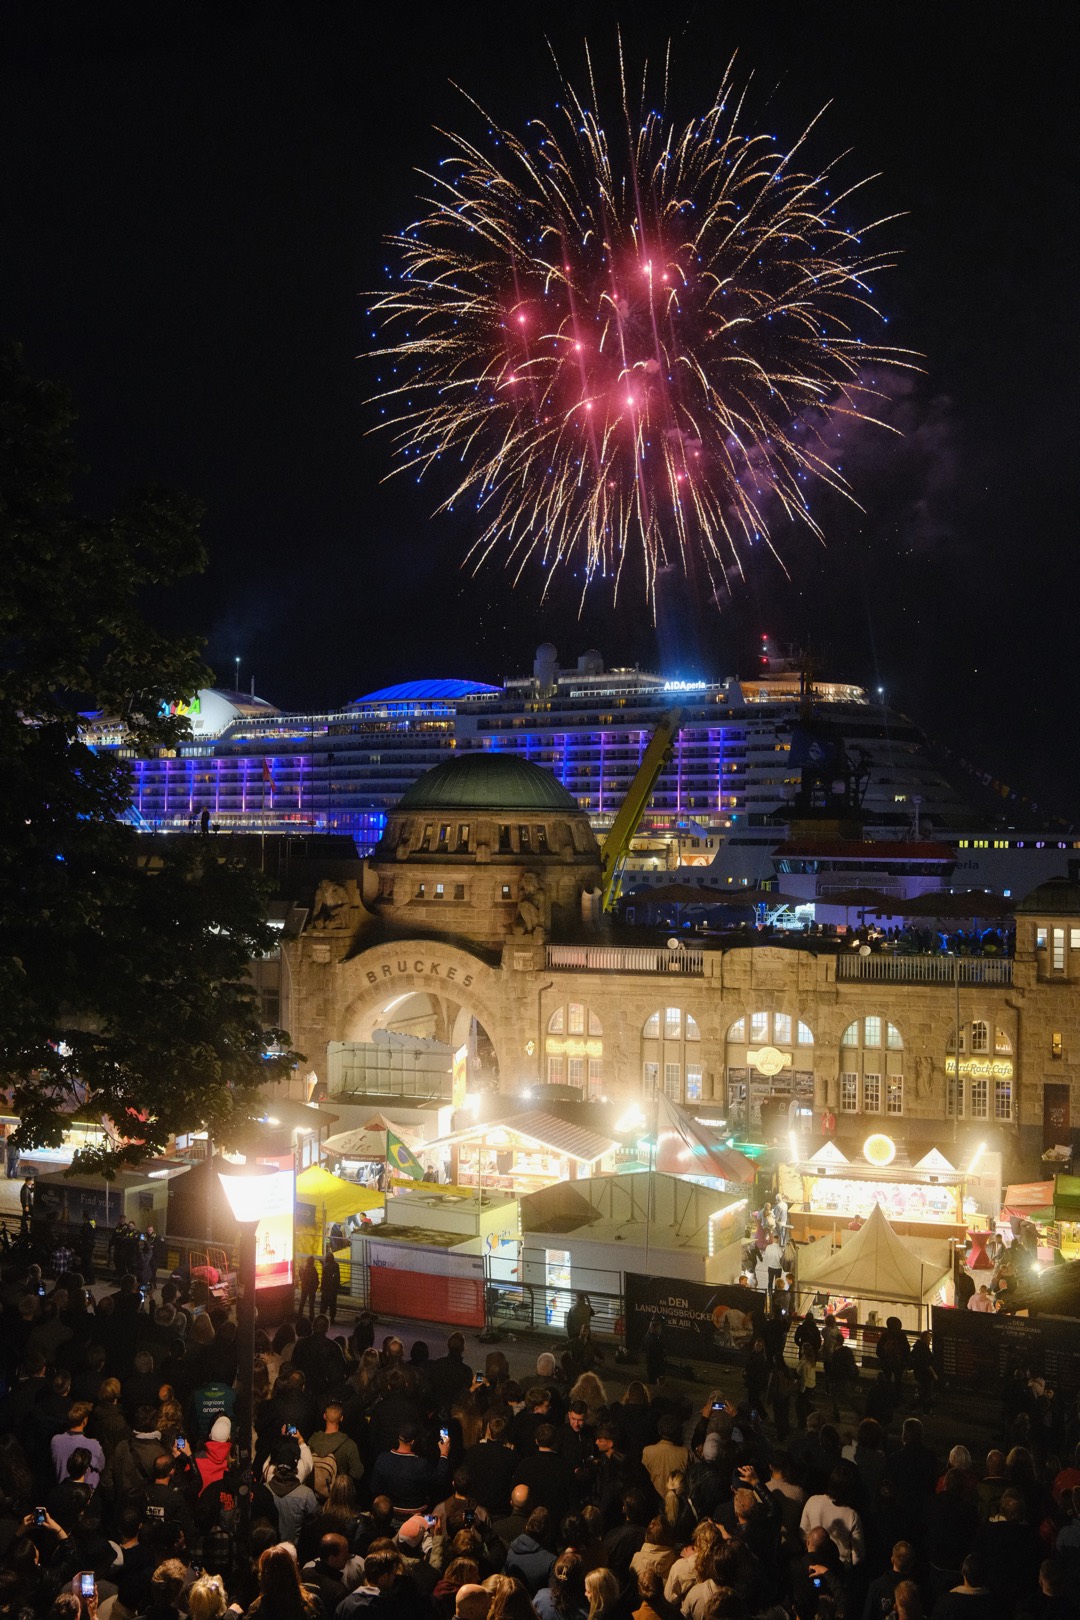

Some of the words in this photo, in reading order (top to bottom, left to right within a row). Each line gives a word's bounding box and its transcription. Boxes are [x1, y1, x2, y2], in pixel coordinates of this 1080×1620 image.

[664, 680, 706, 691] AIDAperla
[956, 860, 979, 870] erla
[970, 1063, 992, 1075] Rock
[992, 1064, 1012, 1076] Cafe
[80, 1193, 97, 1206] Find
[668, 1296, 689, 1309] DEN
[635, 1303, 716, 1322] LANDUNGSBRÜCKEN
[678, 1319, 691, 1328] AIR
